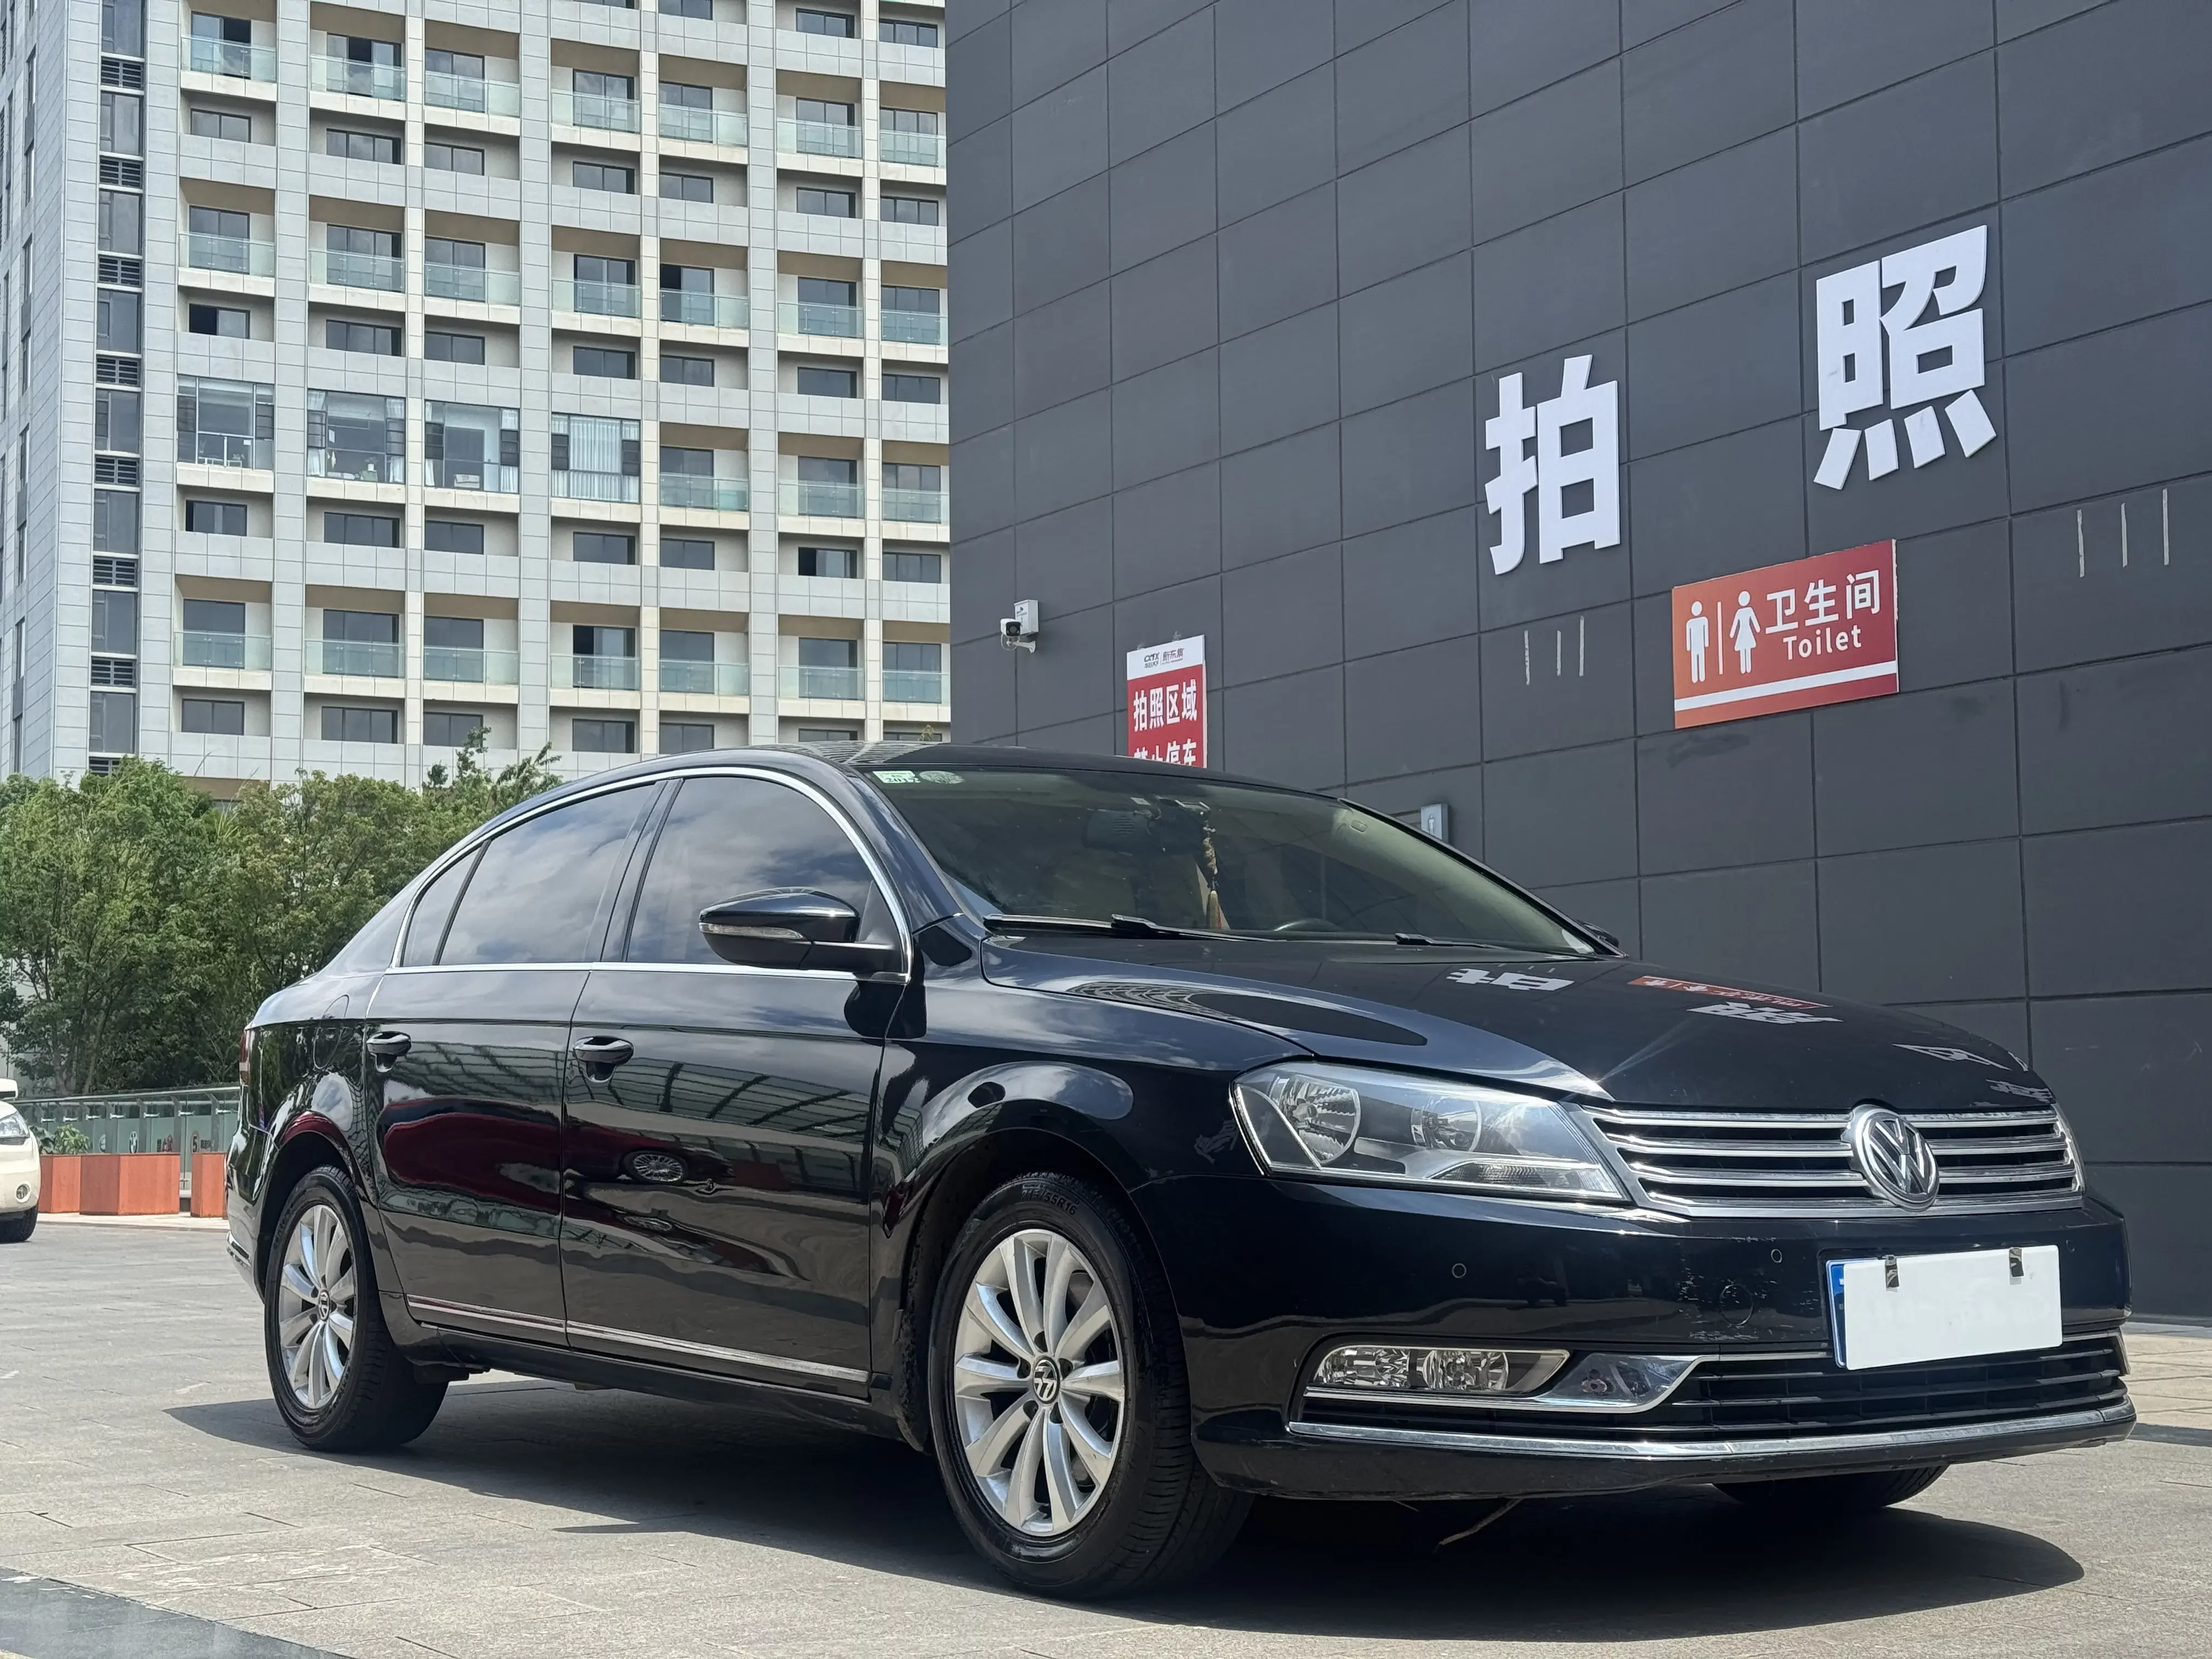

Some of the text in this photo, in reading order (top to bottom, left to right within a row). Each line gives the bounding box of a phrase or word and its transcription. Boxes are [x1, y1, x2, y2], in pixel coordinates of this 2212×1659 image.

[1765, 569, 1881, 635] 卫生间
[1782, 624, 1862, 661] Toilet
[1133, 679, 1198, 732] 拍照区域
[1133, 738, 1197, 766] 停车
